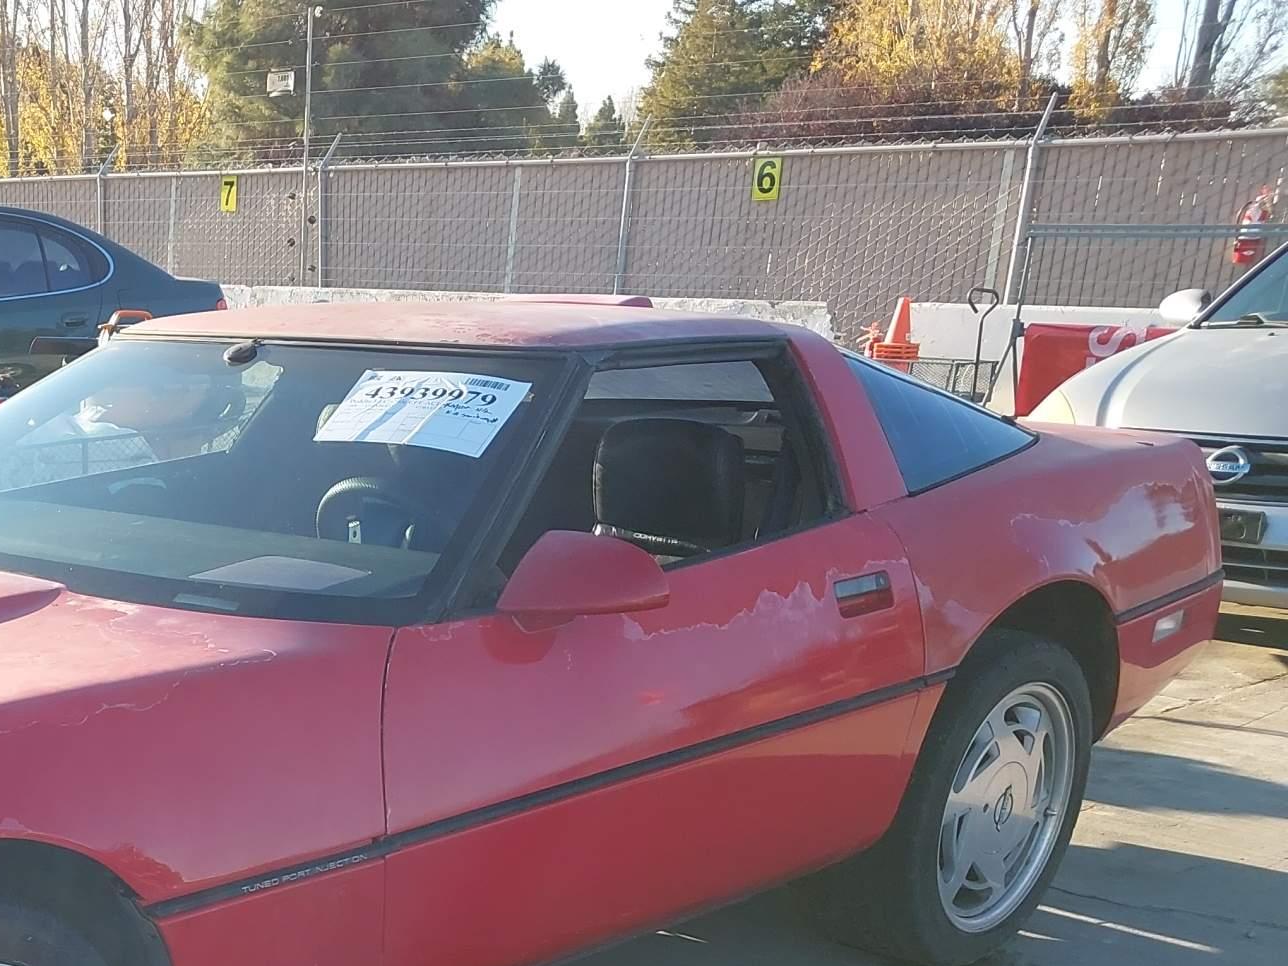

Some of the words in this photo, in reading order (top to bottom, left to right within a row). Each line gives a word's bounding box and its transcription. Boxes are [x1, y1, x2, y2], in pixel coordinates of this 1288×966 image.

[756, 160, 777, 194] 6
[223, 180, 235, 206] 7
[364, 386, 497, 406] 43939979
[241, 877, 280, 893] TUNED
[281, 868, 312, 883] PORT
[313, 854, 368, 873] NJECTON
